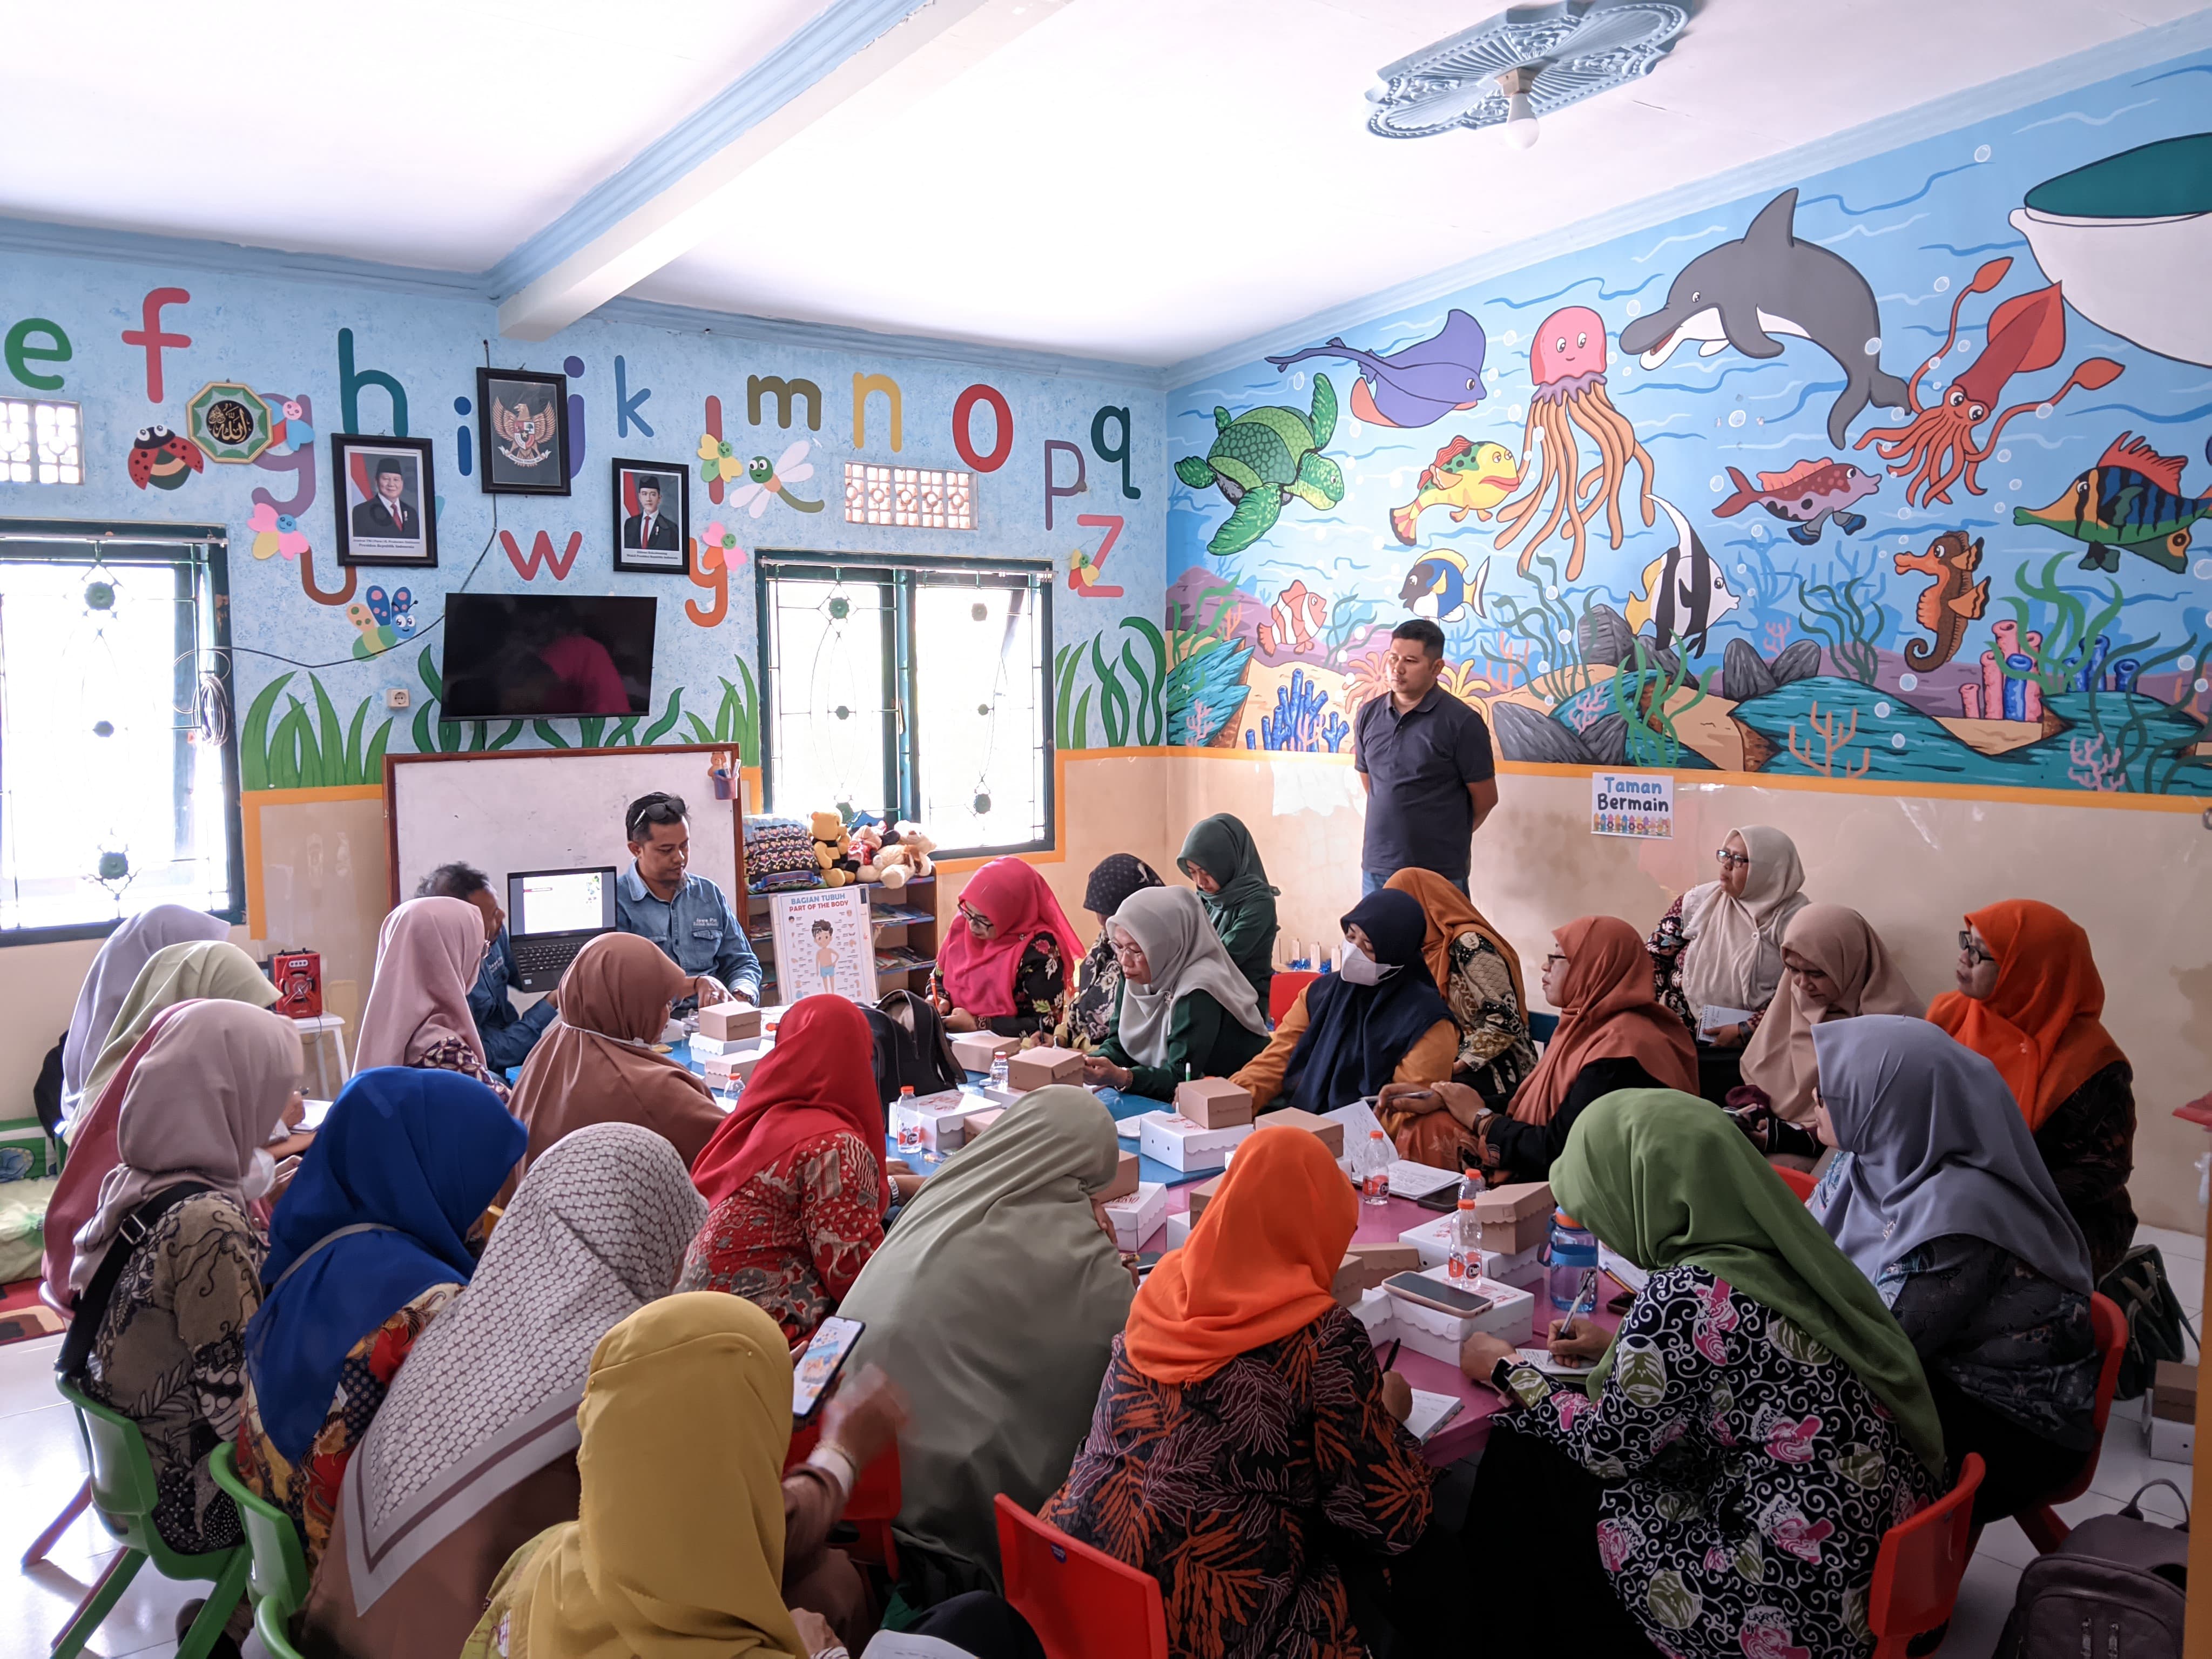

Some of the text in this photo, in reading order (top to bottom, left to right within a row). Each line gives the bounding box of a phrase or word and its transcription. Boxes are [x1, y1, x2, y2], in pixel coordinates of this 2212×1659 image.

[4, 318, 72, 390] e
[122, 287, 191, 403] f
[338, 328, 408, 436] h
[454, 396, 472, 476] i
[614, 355, 654, 438] k
[747, 374, 822, 431] m
[852, 372, 902, 453] n
[1091, 406, 1141, 500] q
[1604, 777, 1662, 794] Taman
[1597, 793, 1669, 812] Bermain
[791, 893, 846, 905] BAGIAN TUBUH
